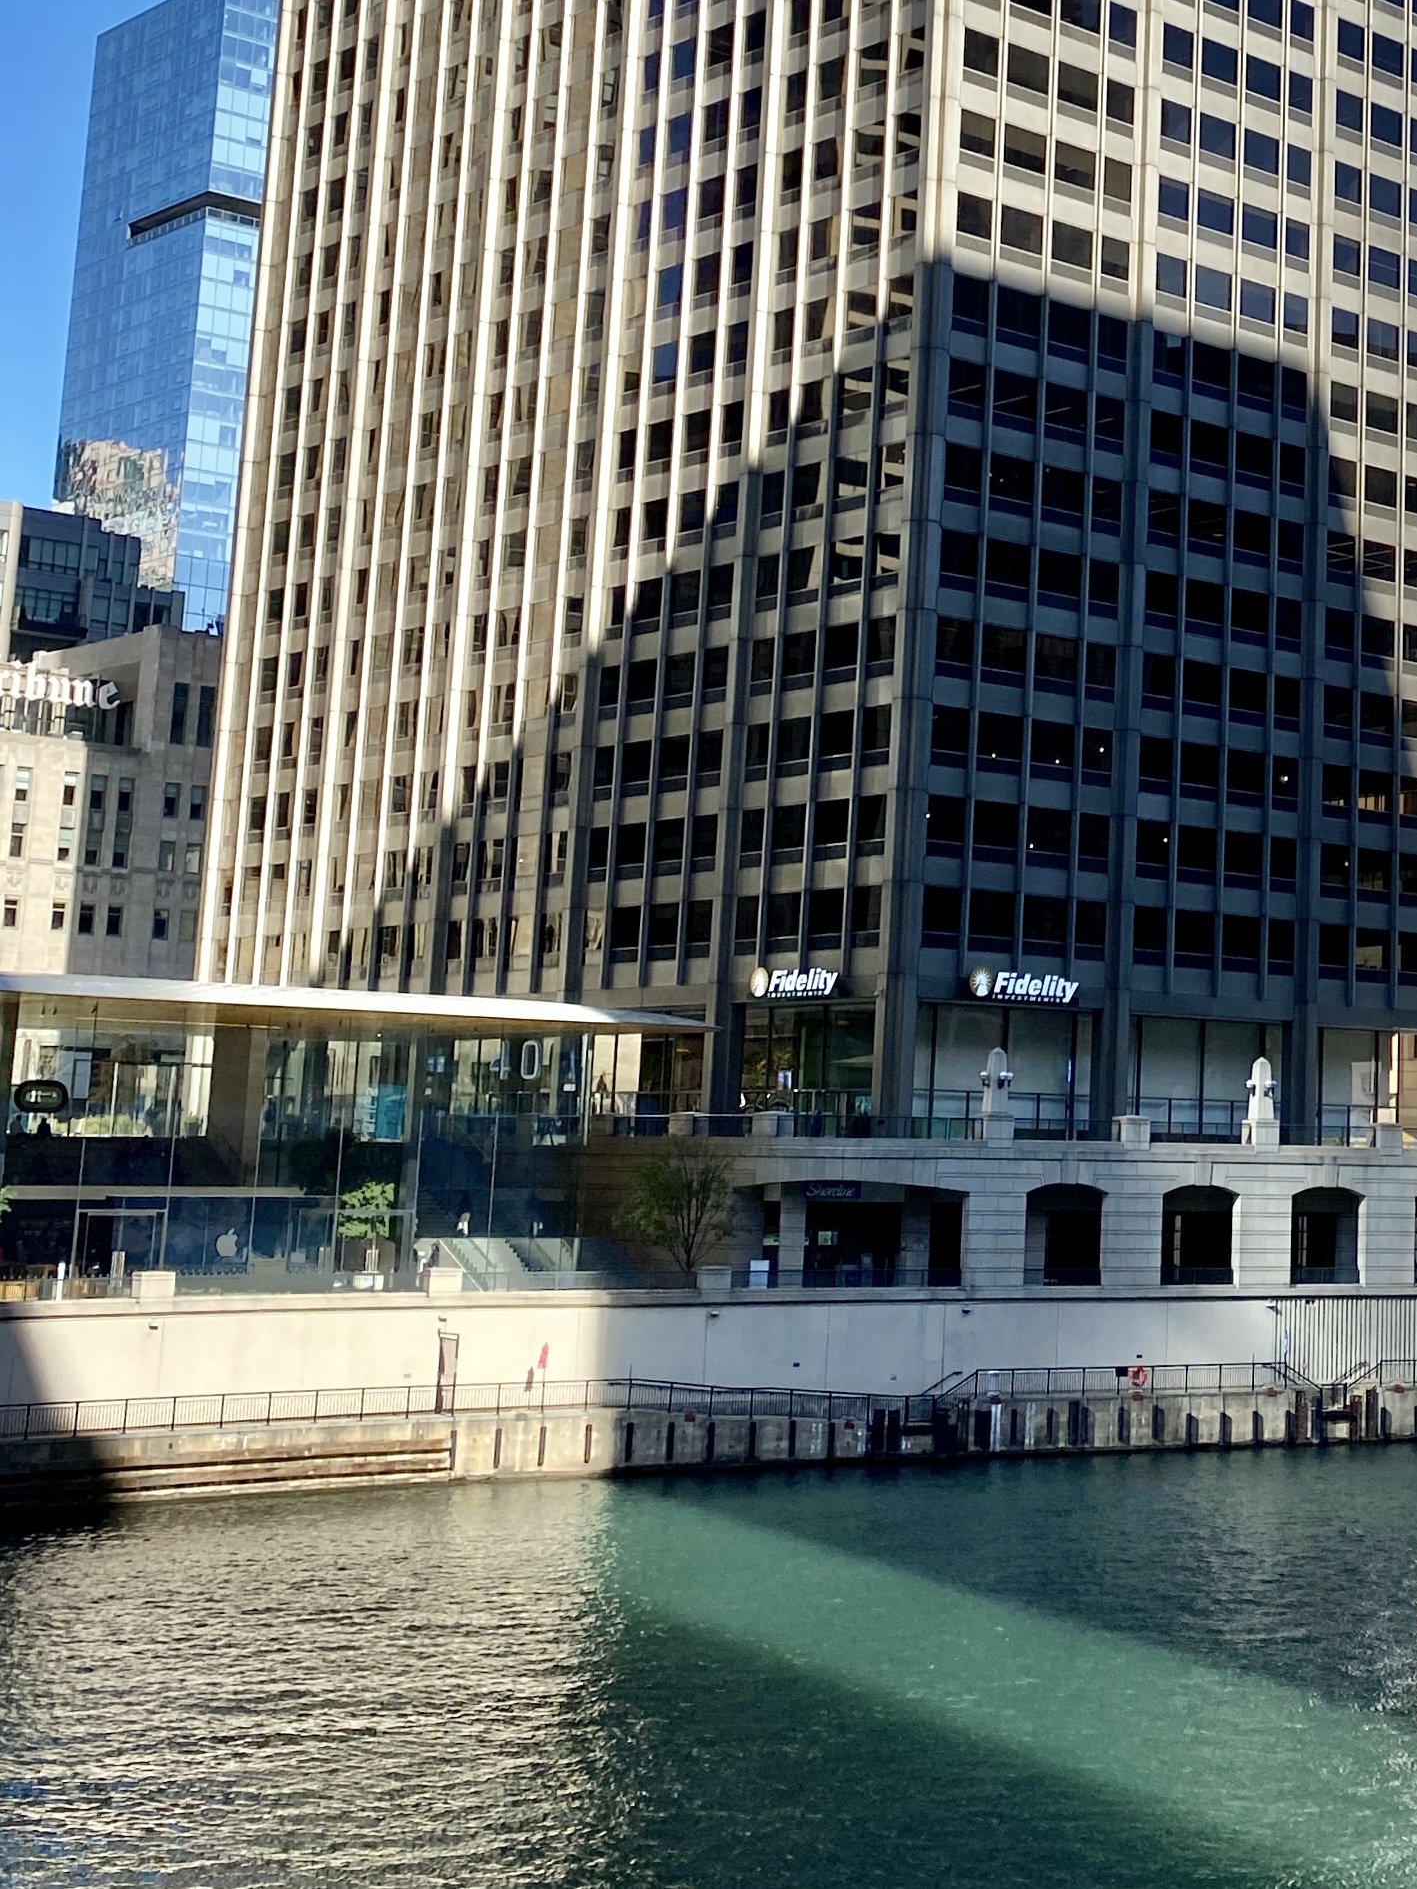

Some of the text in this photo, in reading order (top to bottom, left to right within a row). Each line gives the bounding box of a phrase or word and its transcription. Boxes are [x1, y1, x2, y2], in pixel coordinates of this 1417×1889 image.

[0, 660, 120, 709] ribune
[768, 968, 838, 995] Fidelity
[993, 971, 1079, 1003] Fidelity
[992, 994, 1060, 1003] INVESTMENTS
[805, 1183, 857, 1197] Shoreline
